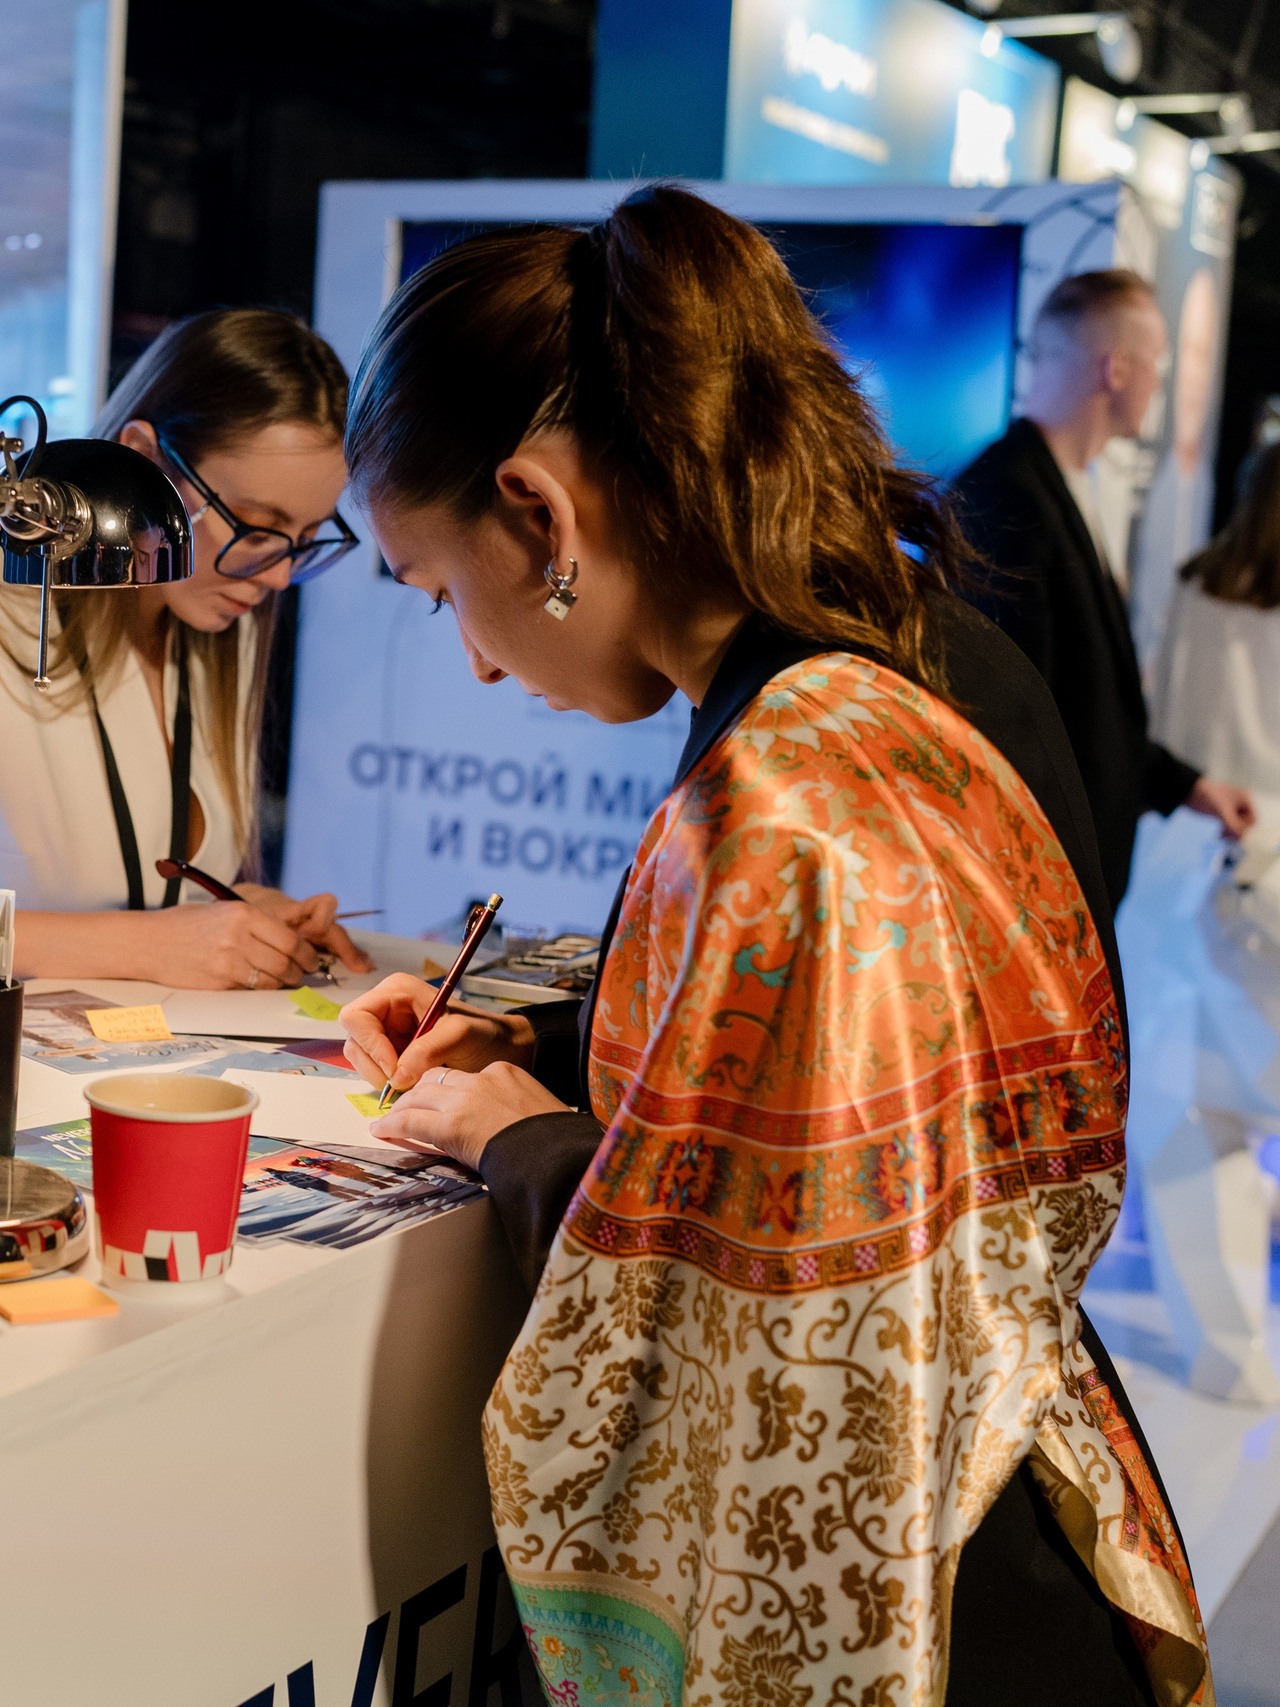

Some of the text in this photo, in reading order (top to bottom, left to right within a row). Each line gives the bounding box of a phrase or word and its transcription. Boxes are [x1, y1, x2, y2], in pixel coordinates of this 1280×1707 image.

[348, 742, 567, 812] ОТКРОЙ
[427, 814, 637, 880] И ВОКР
[236, 1543, 527, 1707] ER
